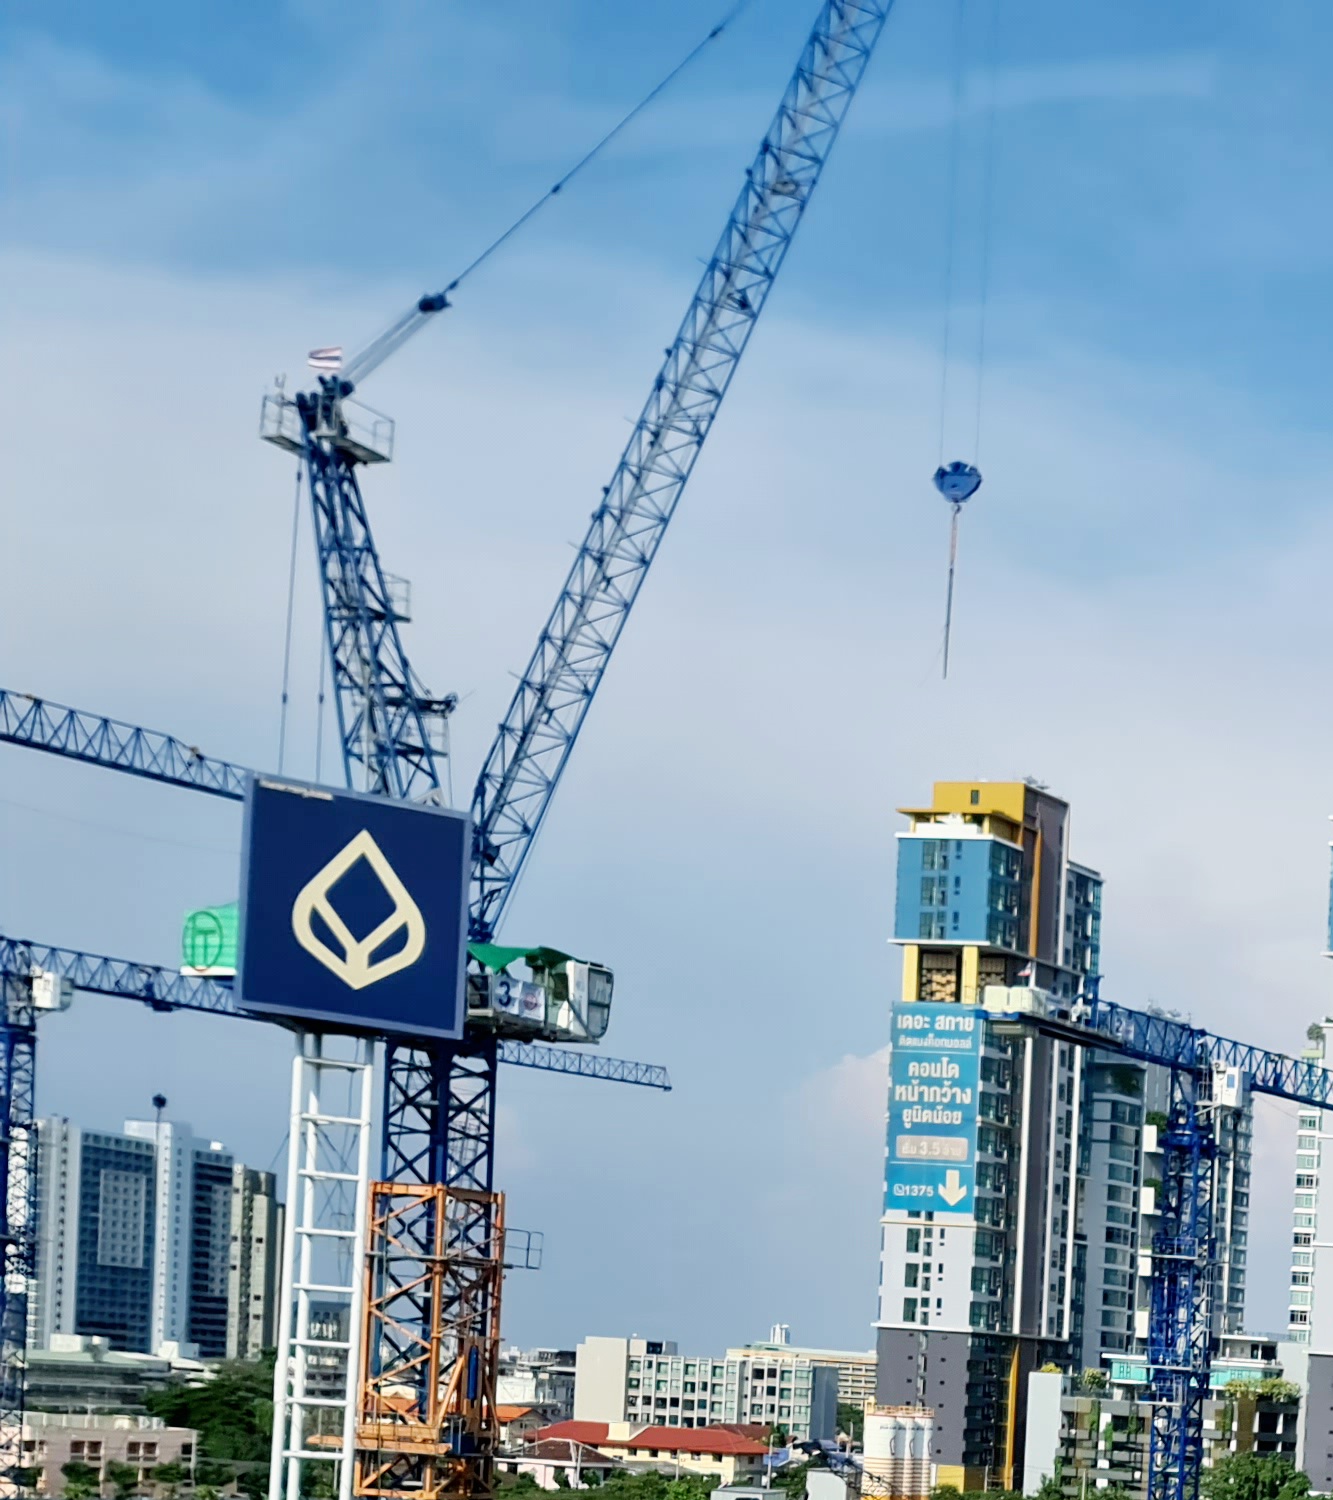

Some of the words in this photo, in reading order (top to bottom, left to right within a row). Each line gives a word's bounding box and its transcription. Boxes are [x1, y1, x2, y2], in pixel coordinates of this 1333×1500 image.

[499, 981, 511, 1007] 3
[935, 1014, 975, 1032] สกาย
[908, 1057, 960, 1078] คอนโด
[895, 1079, 972, 1104] หน้ากว้าง
[920, 1141, 941, 1156] 3.5
[904, 1185, 934, 1197] 1375
